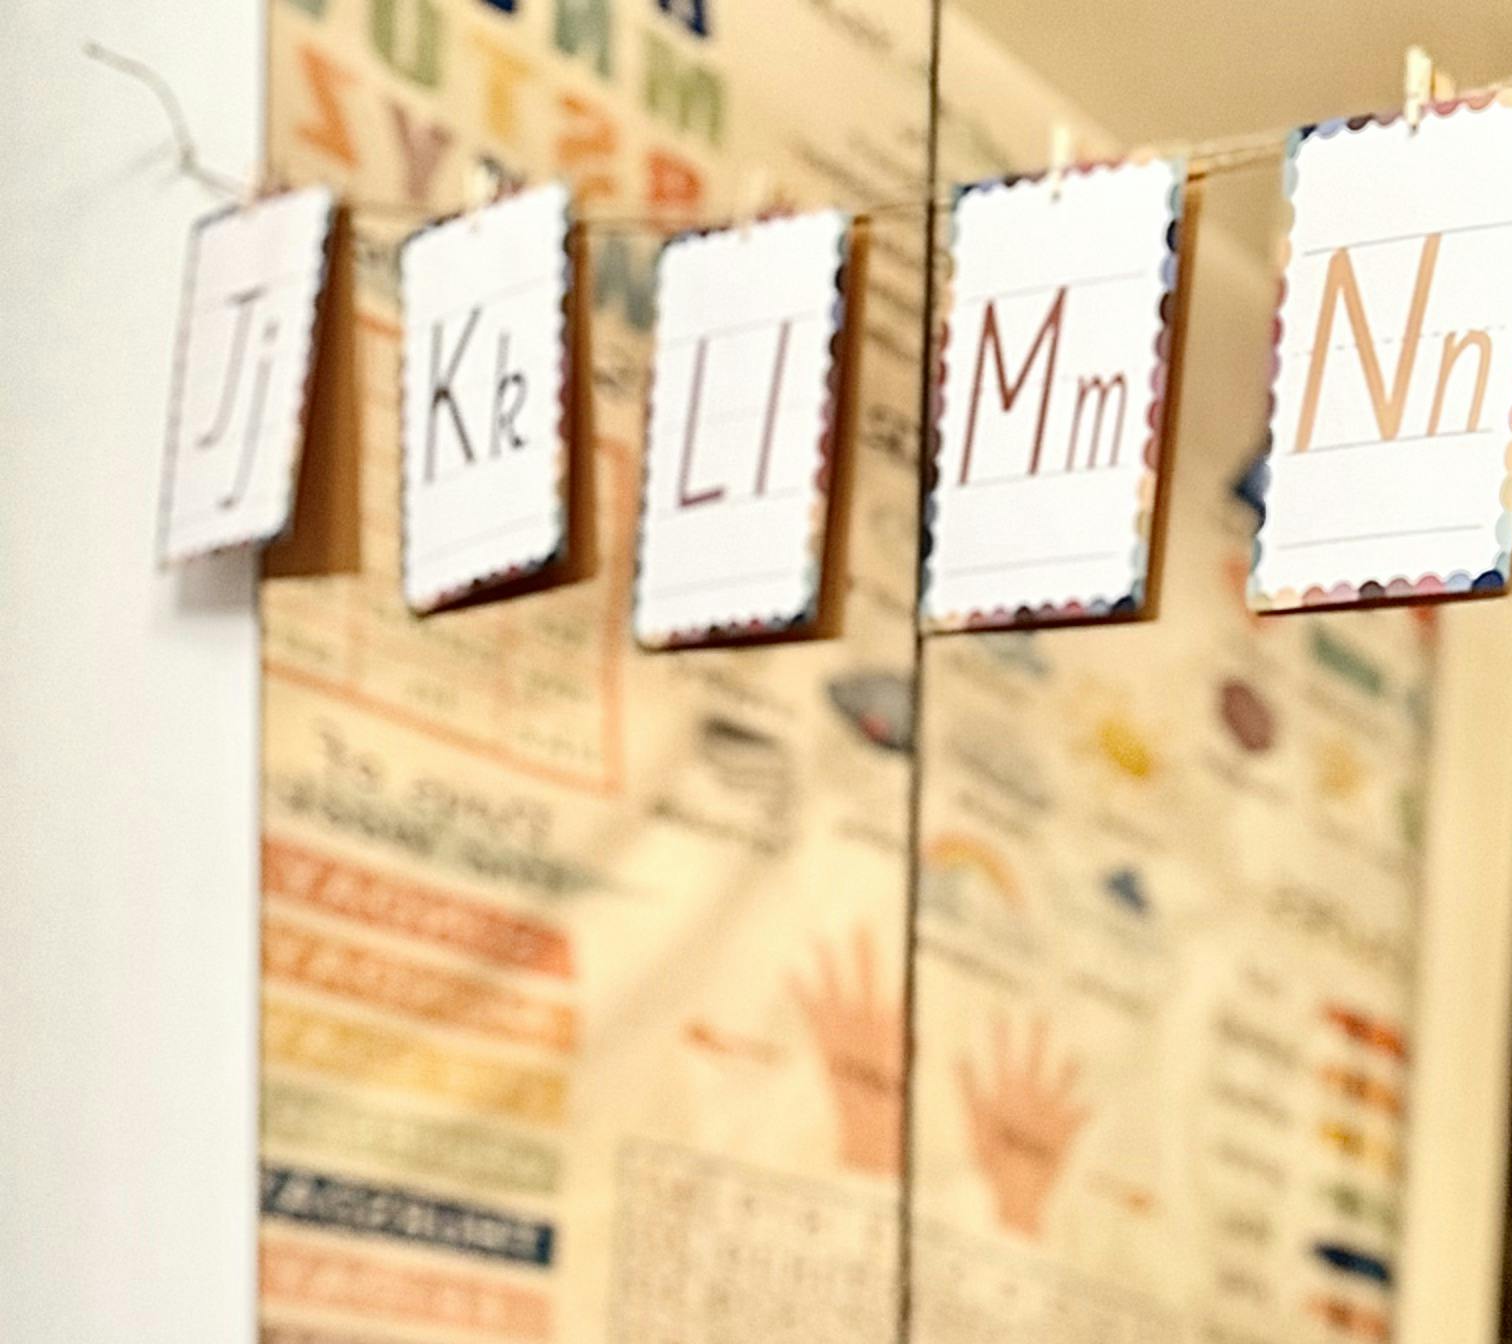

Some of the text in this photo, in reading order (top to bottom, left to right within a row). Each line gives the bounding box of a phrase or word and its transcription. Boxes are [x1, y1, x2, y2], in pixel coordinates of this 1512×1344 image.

[196, 287, 281, 510] Jj
[422, 304, 529, 484] Kk
[958, 285, 1129, 486] Mm
[1294, 232, 1494, 454] Nn
